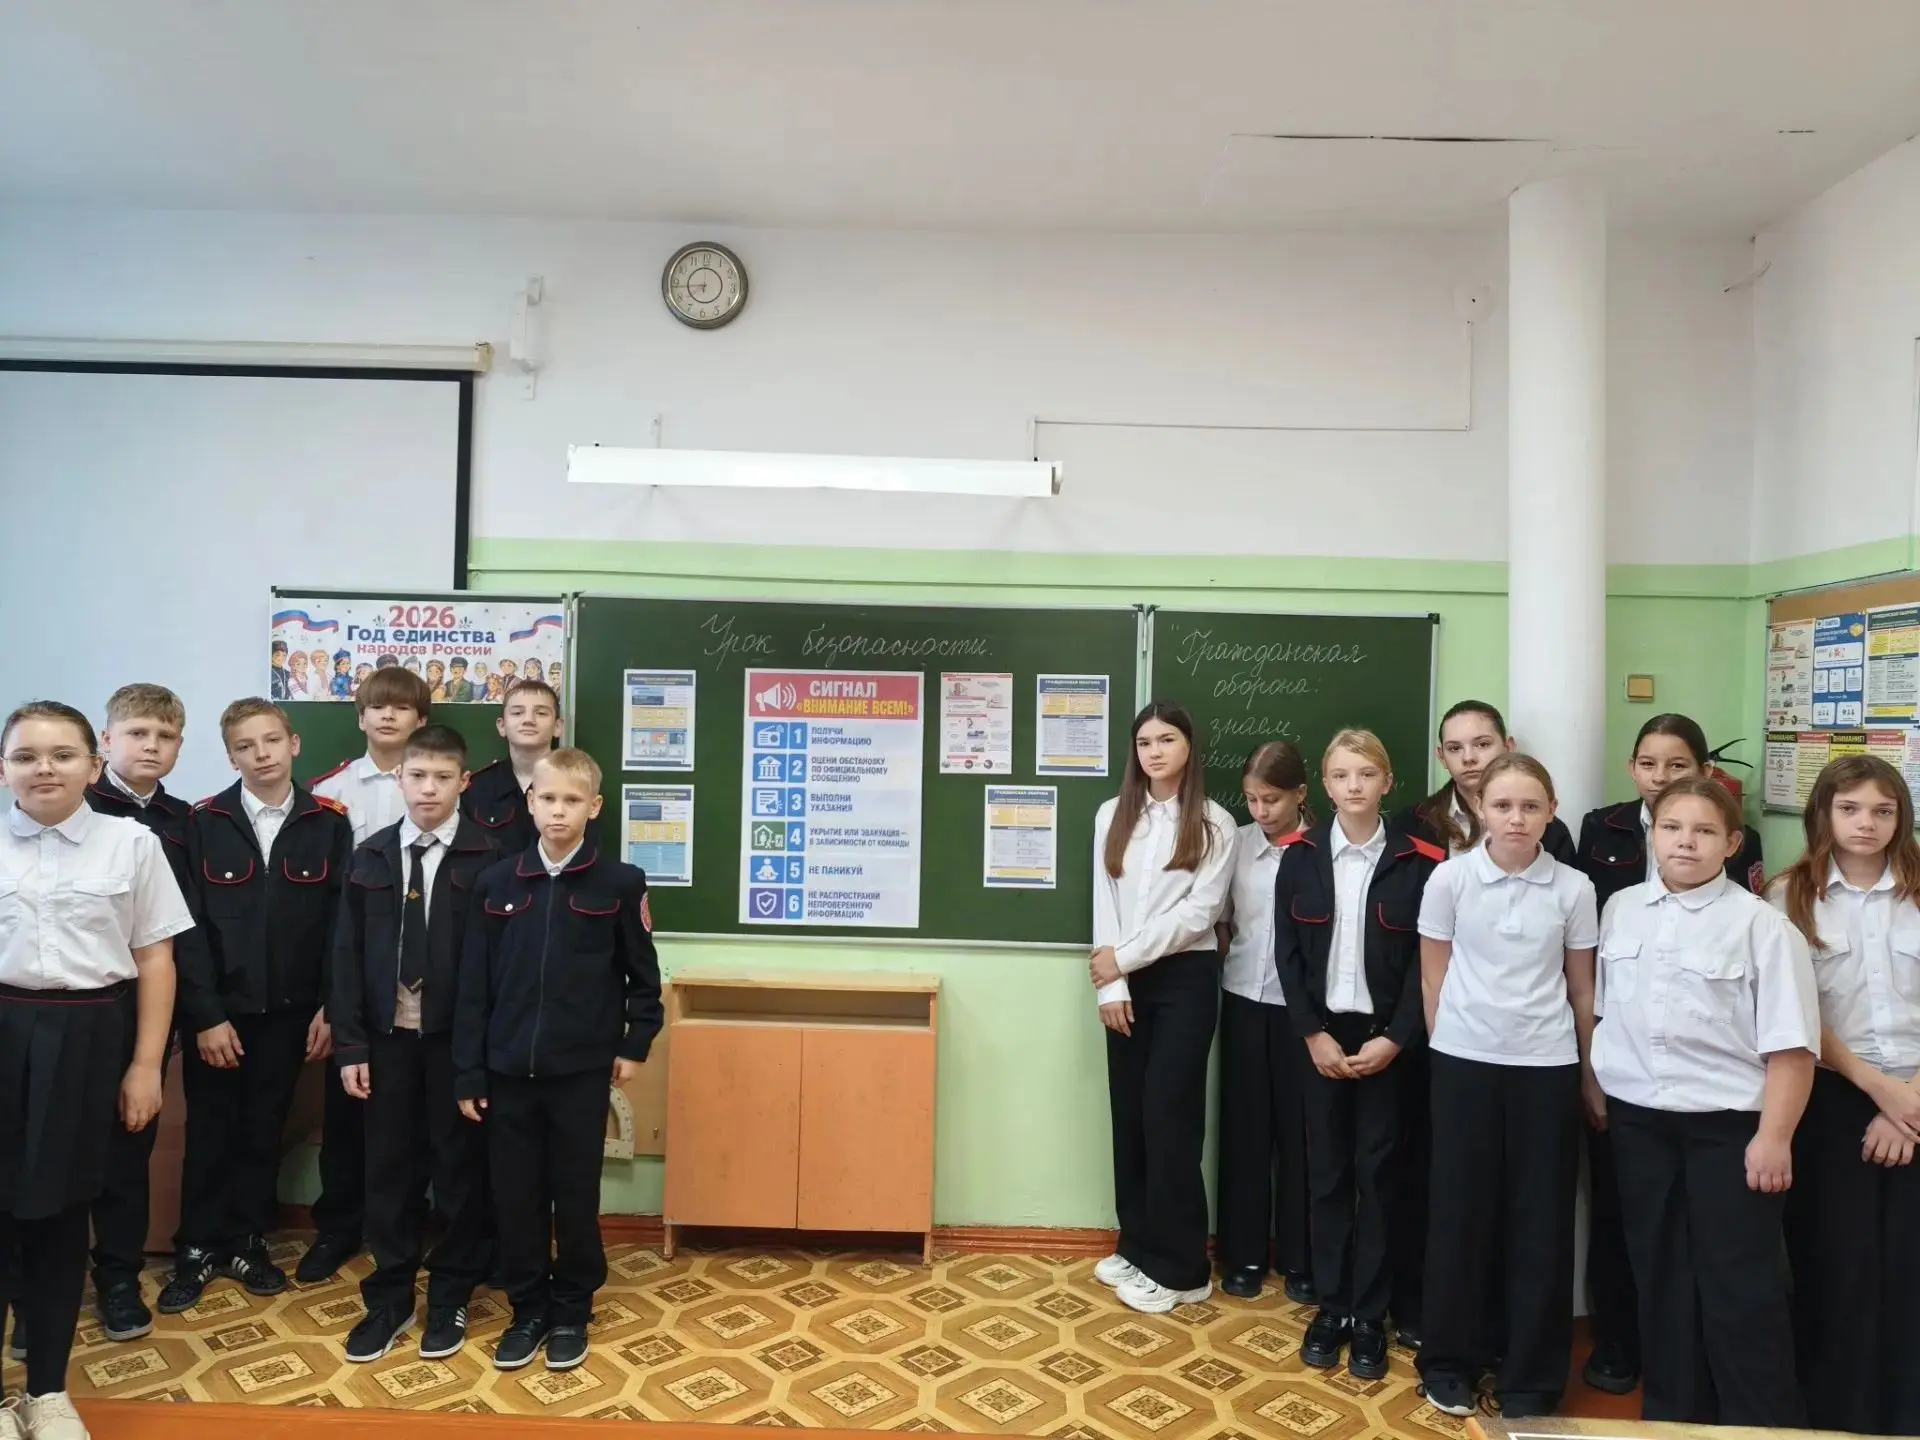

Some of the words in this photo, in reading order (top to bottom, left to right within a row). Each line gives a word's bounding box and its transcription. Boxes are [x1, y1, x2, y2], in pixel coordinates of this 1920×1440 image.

[388, 605, 456, 628] 2026
[347, 625, 386, 643] Год
[392, 627, 496, 644] единства
[700, 614, 776, 671] Урок
[432, 644, 492, 656] России
[809, 680, 878, 698] СИГНАЛ
[797, 698, 869, 714] «ВНИМАНИЕ
[871, 700, 914, 716] ВСЕМ!»
[793, 728, 802, 744] 1
[811, 727, 844, 736] ПОЛУЧИ
[811, 737, 872, 747] ИНФОРМАЦИЮ
[791, 759, 803, 776] 2
[811, 757, 838, 766] ОЦЕНИ
[839, 757, 886, 766] ОБСТАНОВКУ
[811, 766, 822, 774] ПО
[823, 766, 888, 775] ОФИЦИАЛЬНОМУ
[811, 775, 861, 783] СООБЩЕНИЮ
[791, 793, 802, 811] 3
[810, 793, 851, 802] ВЫПОЛНИ
[810, 803, 853, 812] УКАЗАНИЯ
[789, 828, 802, 846] 4
[809, 828, 842, 836] УКРЫТИЕ
[844, 828, 859, 836] ИЛИ
[861, 829, 900, 837] ЭВАКУАЦИЯ
[815, 839, 866, 847] ЗАВИСИМОСТИ
[877, 840, 910, 848] КОМАНДЫ
[789, 862, 801, 878] 5
[808, 865, 819, 875] НЕ
[821, 864, 863, 876] ПАНИКУЙ
[808, 891, 818, 899] НЕ
[819, 891, 880, 901] РАСПРОСТРАНЯЙ
[788, 895, 800, 913] 6
[807, 900, 873, 910] НЕПРОВЕРЕННУЮ
[807, 909, 864, 919] ИНФОРМАЦИЮ
